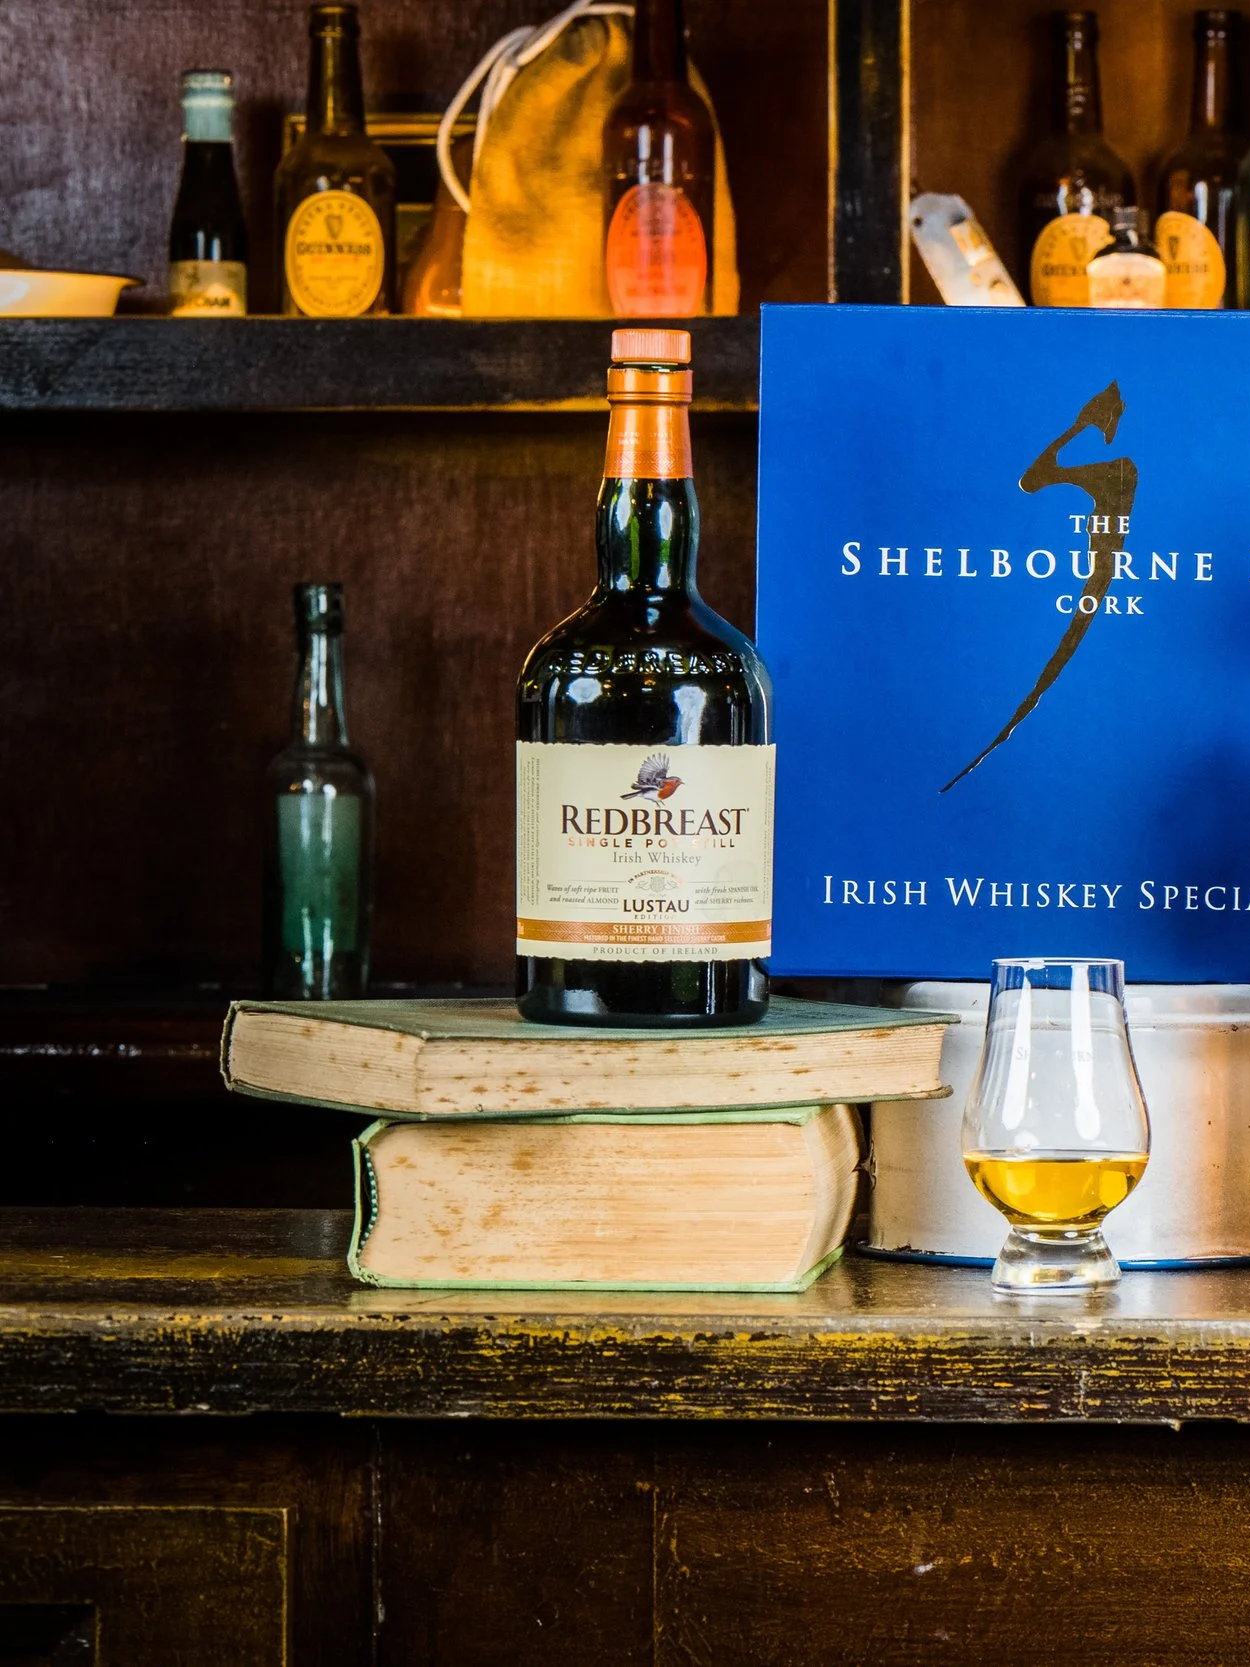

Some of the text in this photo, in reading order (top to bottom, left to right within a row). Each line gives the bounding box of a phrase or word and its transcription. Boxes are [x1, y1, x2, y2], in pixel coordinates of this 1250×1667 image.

[296, 242, 372, 255] GUINNESS
[1070, 514, 1131, 535] THE
[841, 541, 1214, 582] SHELBOURNE
[1056, 594, 1144, 616] CORK
[562, 804, 747, 836] REDBREAST
[568, 837, 736, 848] SINGLE POT STILL
[613, 852, 702, 867] Irish Whiskey
[584, 886, 596, 894] ripe
[694, 886, 710, 894] with
[824, 875, 927, 906] IRISH
[945, 876, 1122, 910] WHISKEY
[624, 900, 690, 912] LUSTAU
[612, 924, 699, 934] SHERRY FINISH
